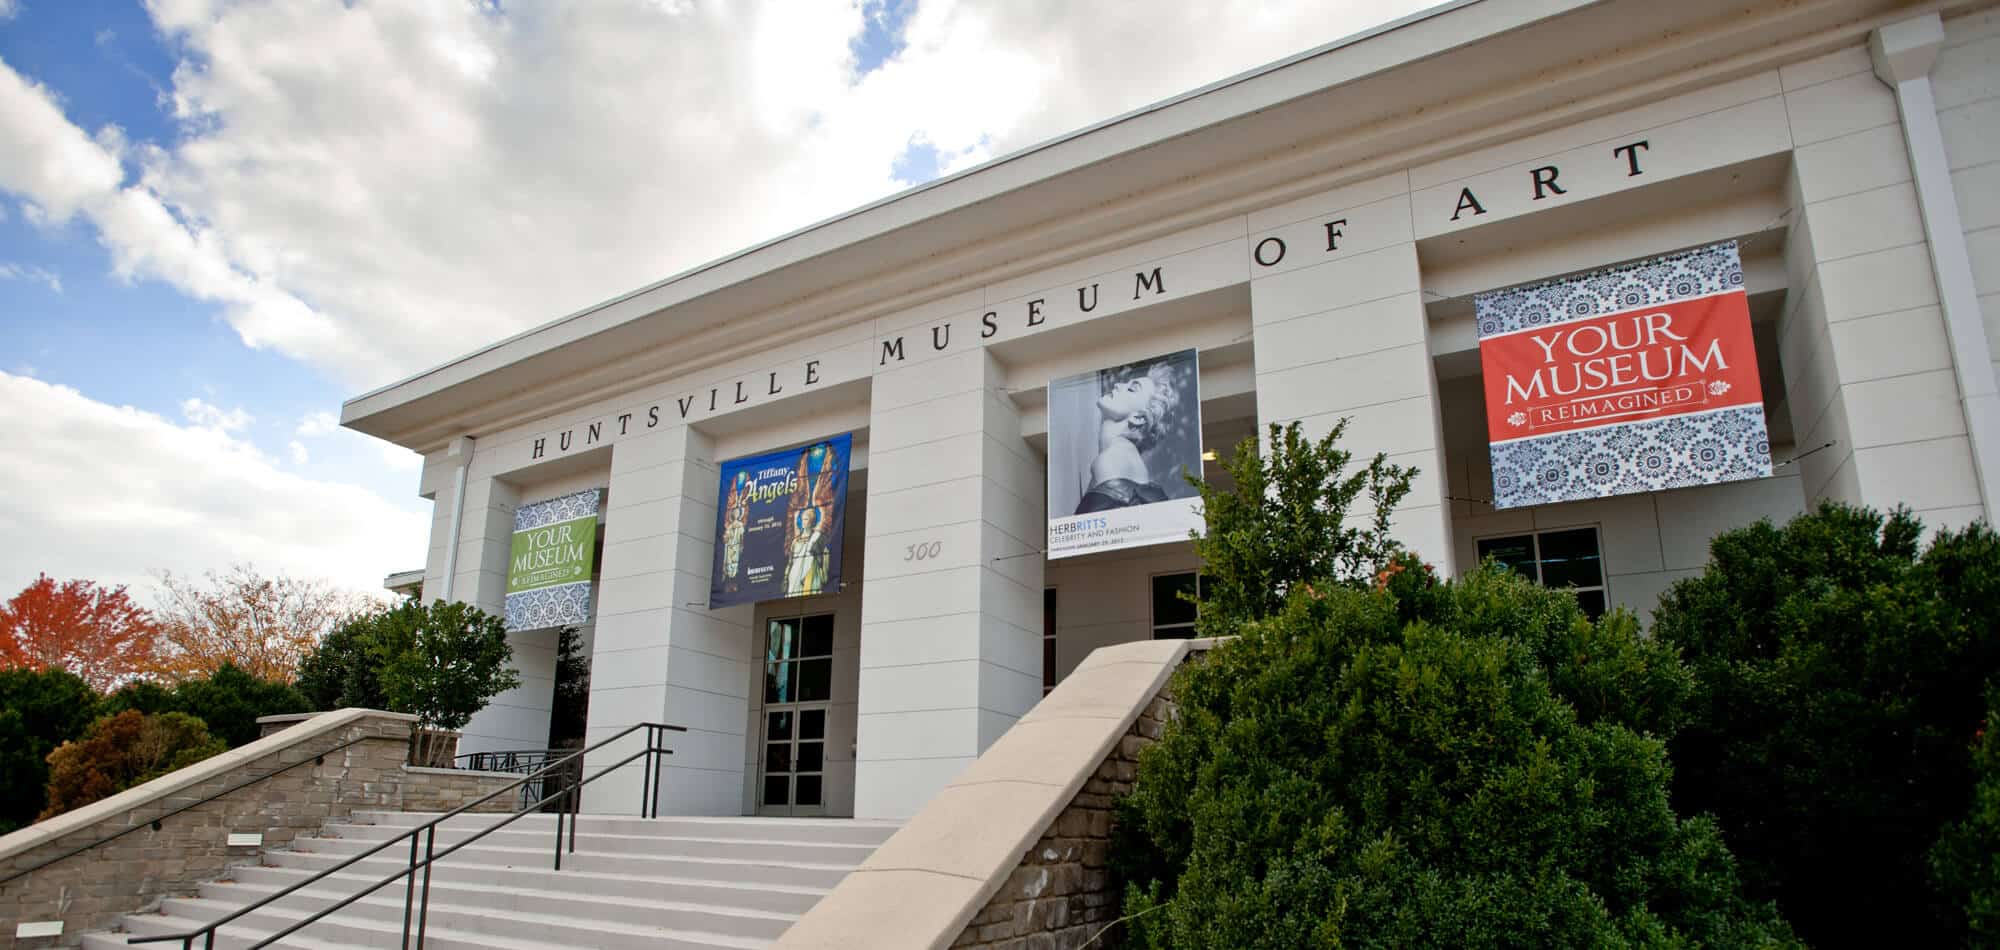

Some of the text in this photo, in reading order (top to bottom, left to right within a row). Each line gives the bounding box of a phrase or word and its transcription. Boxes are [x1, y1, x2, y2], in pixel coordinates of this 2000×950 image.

[532, 140, 1649, 459] HUNTSVILLE MUSEUM OF ART
[1530, 312, 1688, 364] YOUR
[1505, 338, 1730, 405] MUSEUM
[1541, 387, 1693, 423] REIMAGINED
[744, 470, 798, 504] Angels
[757, 467, 788, 481] Tiffany
[527, 525, 573, 551] YOUR
[1049, 524, 1140, 545] CELEBRITY AND FASHION
[512, 543, 584, 575] MUSEUM
[904, 541, 942, 562] 300
